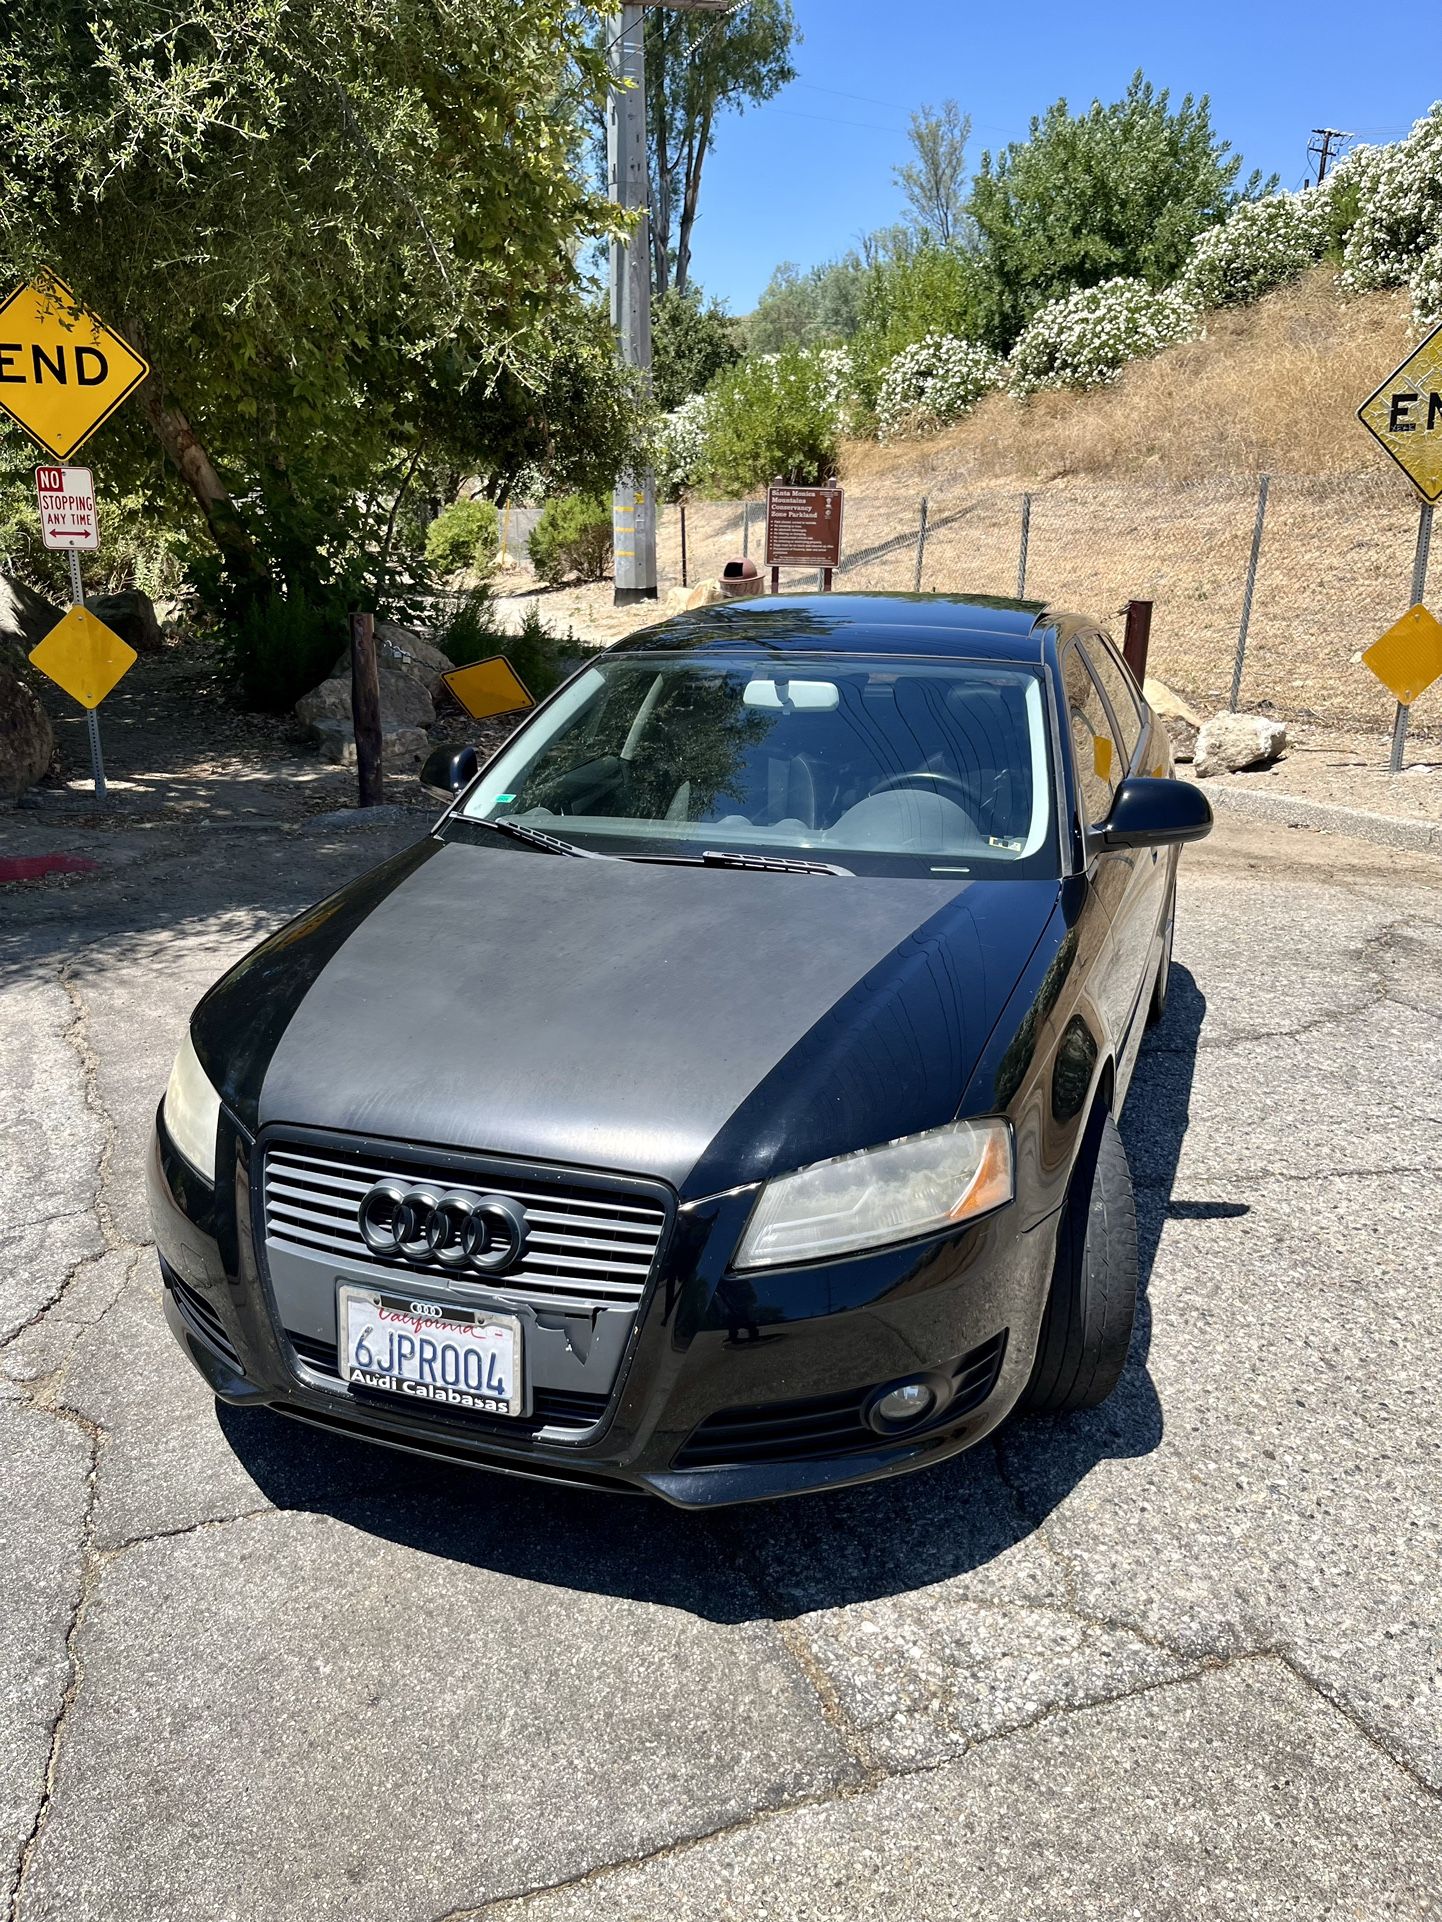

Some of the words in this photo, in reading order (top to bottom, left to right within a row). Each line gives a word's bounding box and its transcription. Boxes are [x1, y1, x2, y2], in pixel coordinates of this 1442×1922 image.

[0, 343, 109, 386] END
[40, 470, 60, 489] NO
[42, 495, 93, 511] STOPPING
[771, 504, 812, 512] Conservancy
[47, 513, 67, 525] ANY
[71, 514, 92, 526] TIME
[355, 1326, 505, 1395] 6JPR004
[351, 1369, 397, 1390] Audi
[402, 1381, 509, 1413] Calabasas
